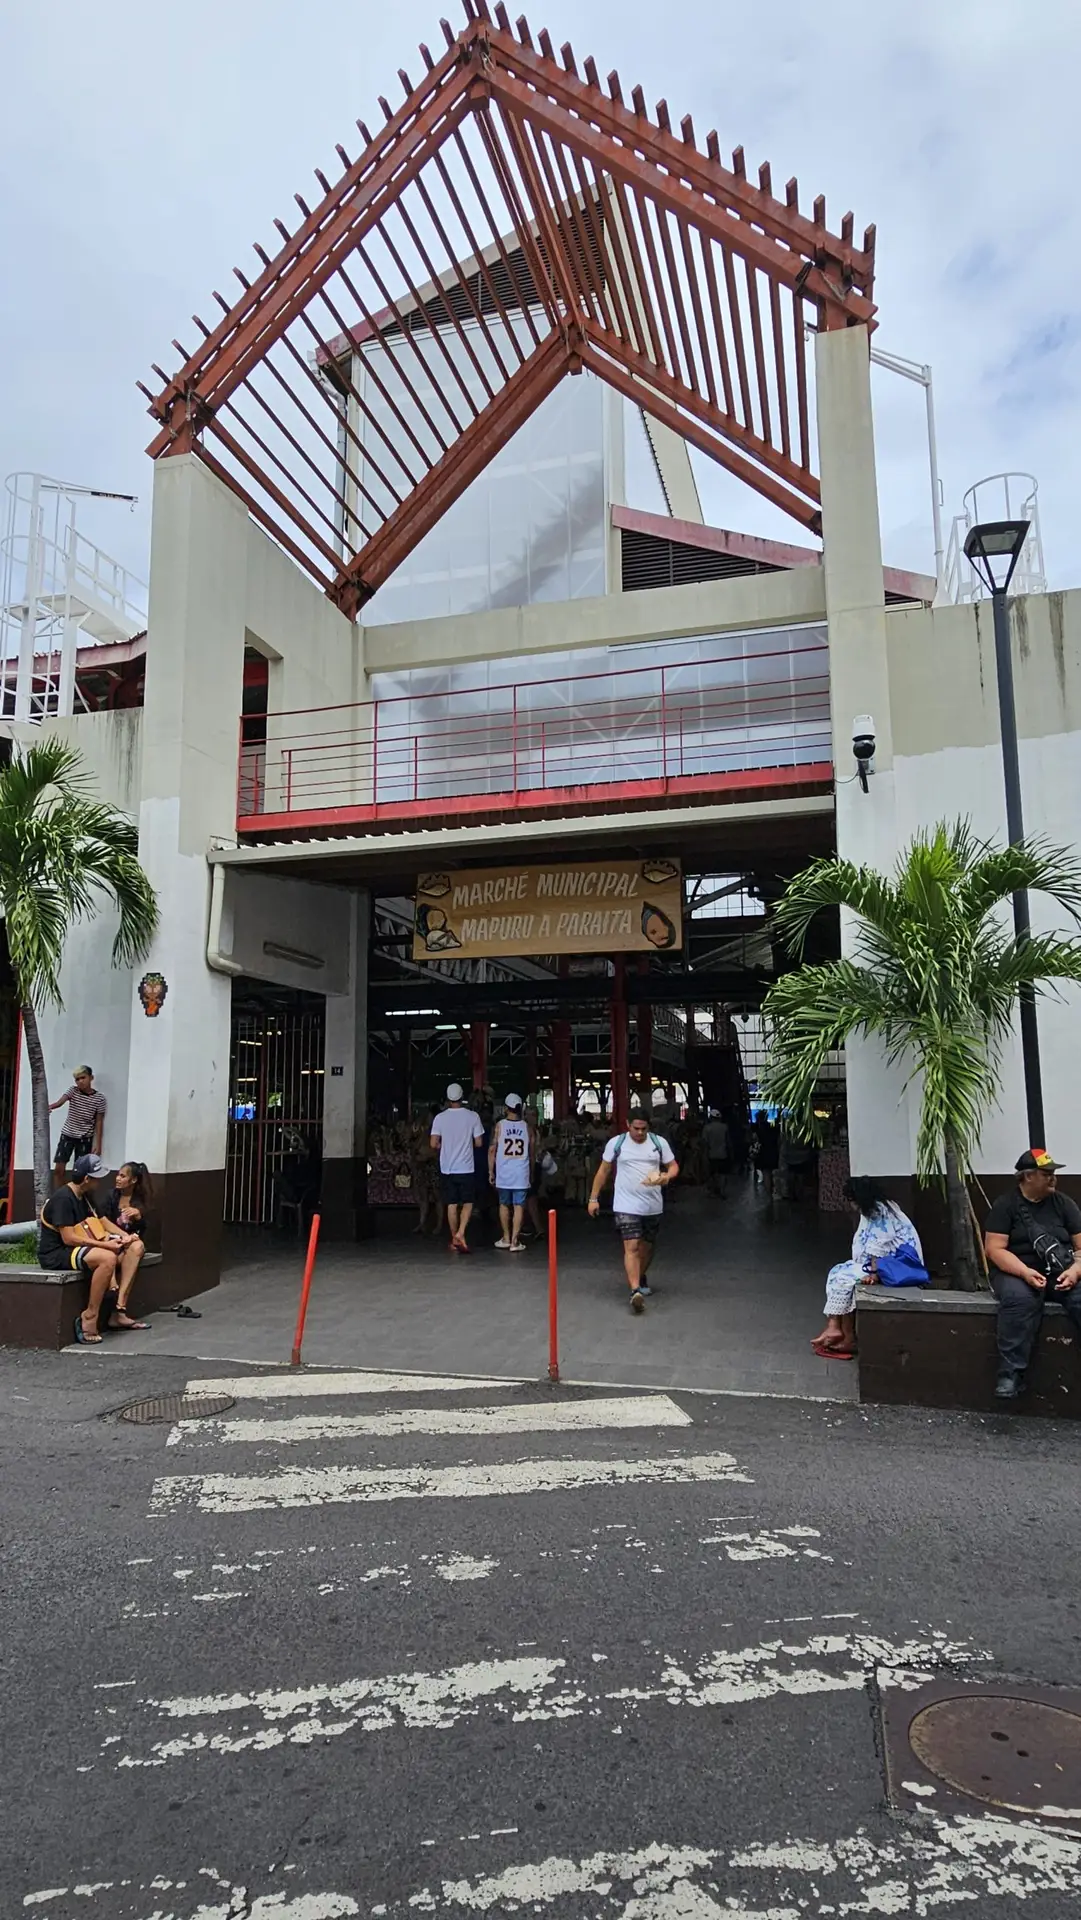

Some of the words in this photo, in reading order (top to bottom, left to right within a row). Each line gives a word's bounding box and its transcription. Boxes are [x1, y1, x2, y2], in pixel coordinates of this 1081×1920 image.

[452, 871, 529, 910] MARCHÉ
[536, 871, 639, 898] MUNICIPAL
[460, 914, 534, 942] MAPURU
[538, 914, 551, 938] A
[556, 909, 632, 937] PARAITA
[504, 1138, 525, 1156] 23
